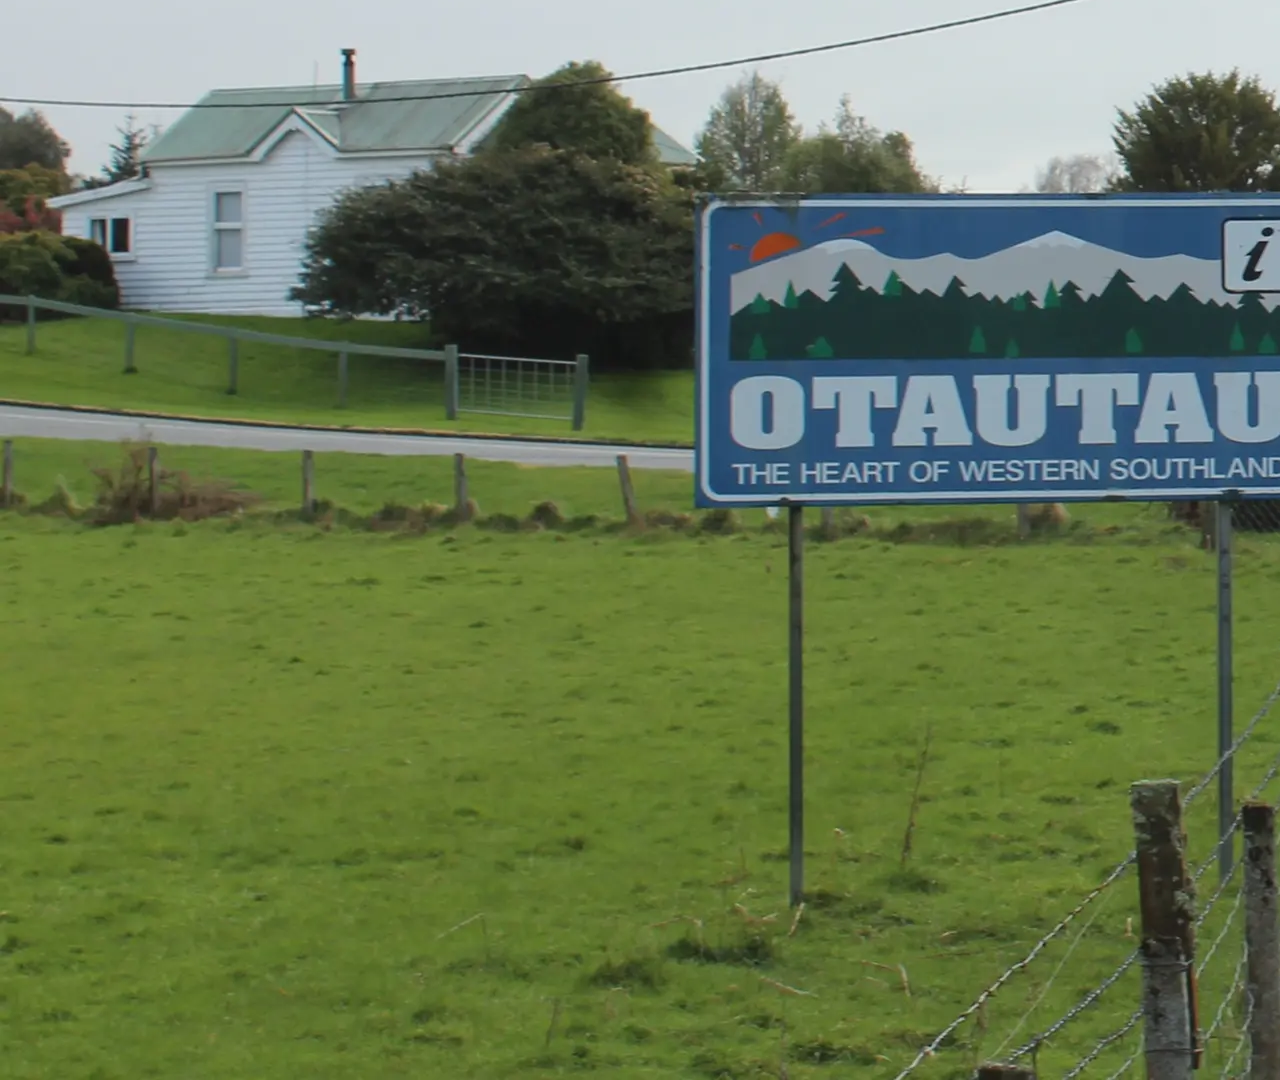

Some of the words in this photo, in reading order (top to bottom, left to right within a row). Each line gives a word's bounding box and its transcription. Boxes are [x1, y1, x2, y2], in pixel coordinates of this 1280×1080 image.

[1241, 226, 1274, 283] i
[731, 463, 789, 485] THE
[801, 462, 900, 484] HEART
[910, 461, 950, 483] OF
[958, 459, 1100, 482] WESTERN
